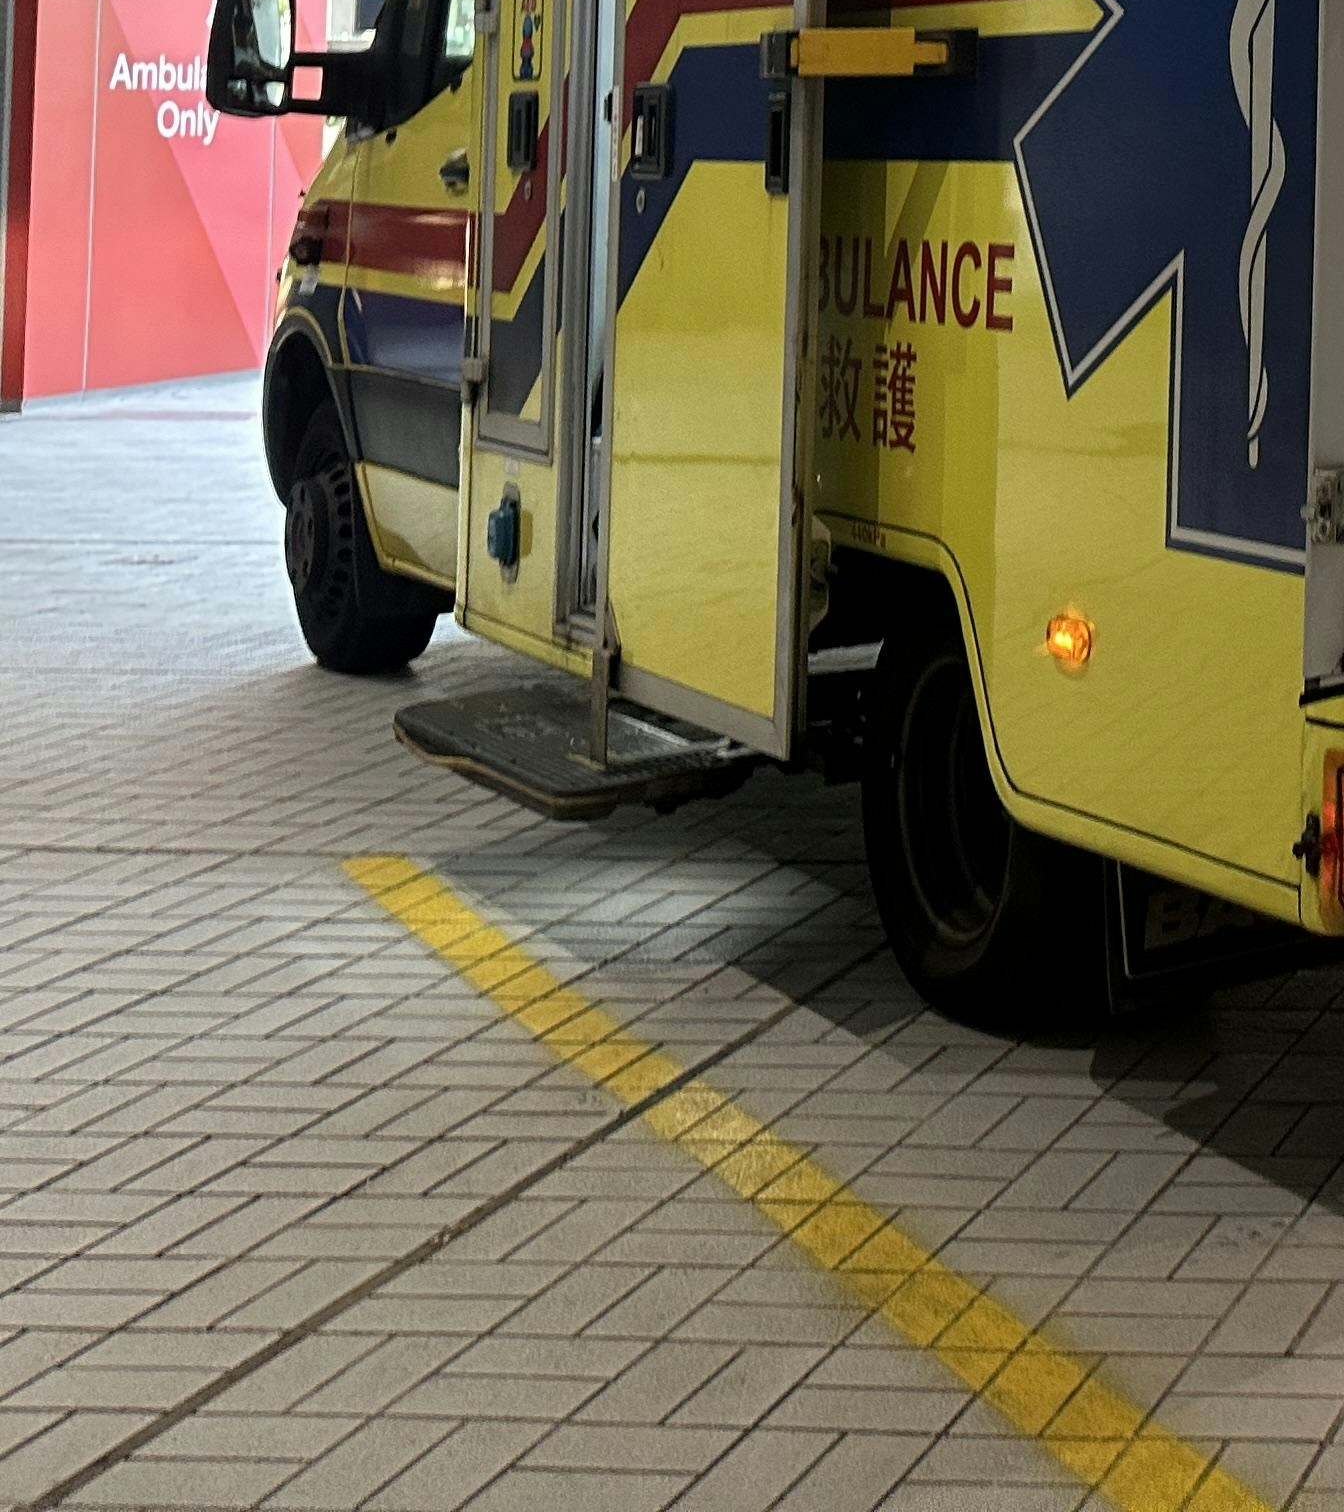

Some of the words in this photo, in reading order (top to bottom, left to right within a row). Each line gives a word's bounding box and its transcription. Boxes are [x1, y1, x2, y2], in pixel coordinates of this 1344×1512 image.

[109, 52, 207, 91] Ambul
[156, 99, 221, 146] Only
[820, 335, 917, 454] 救護
